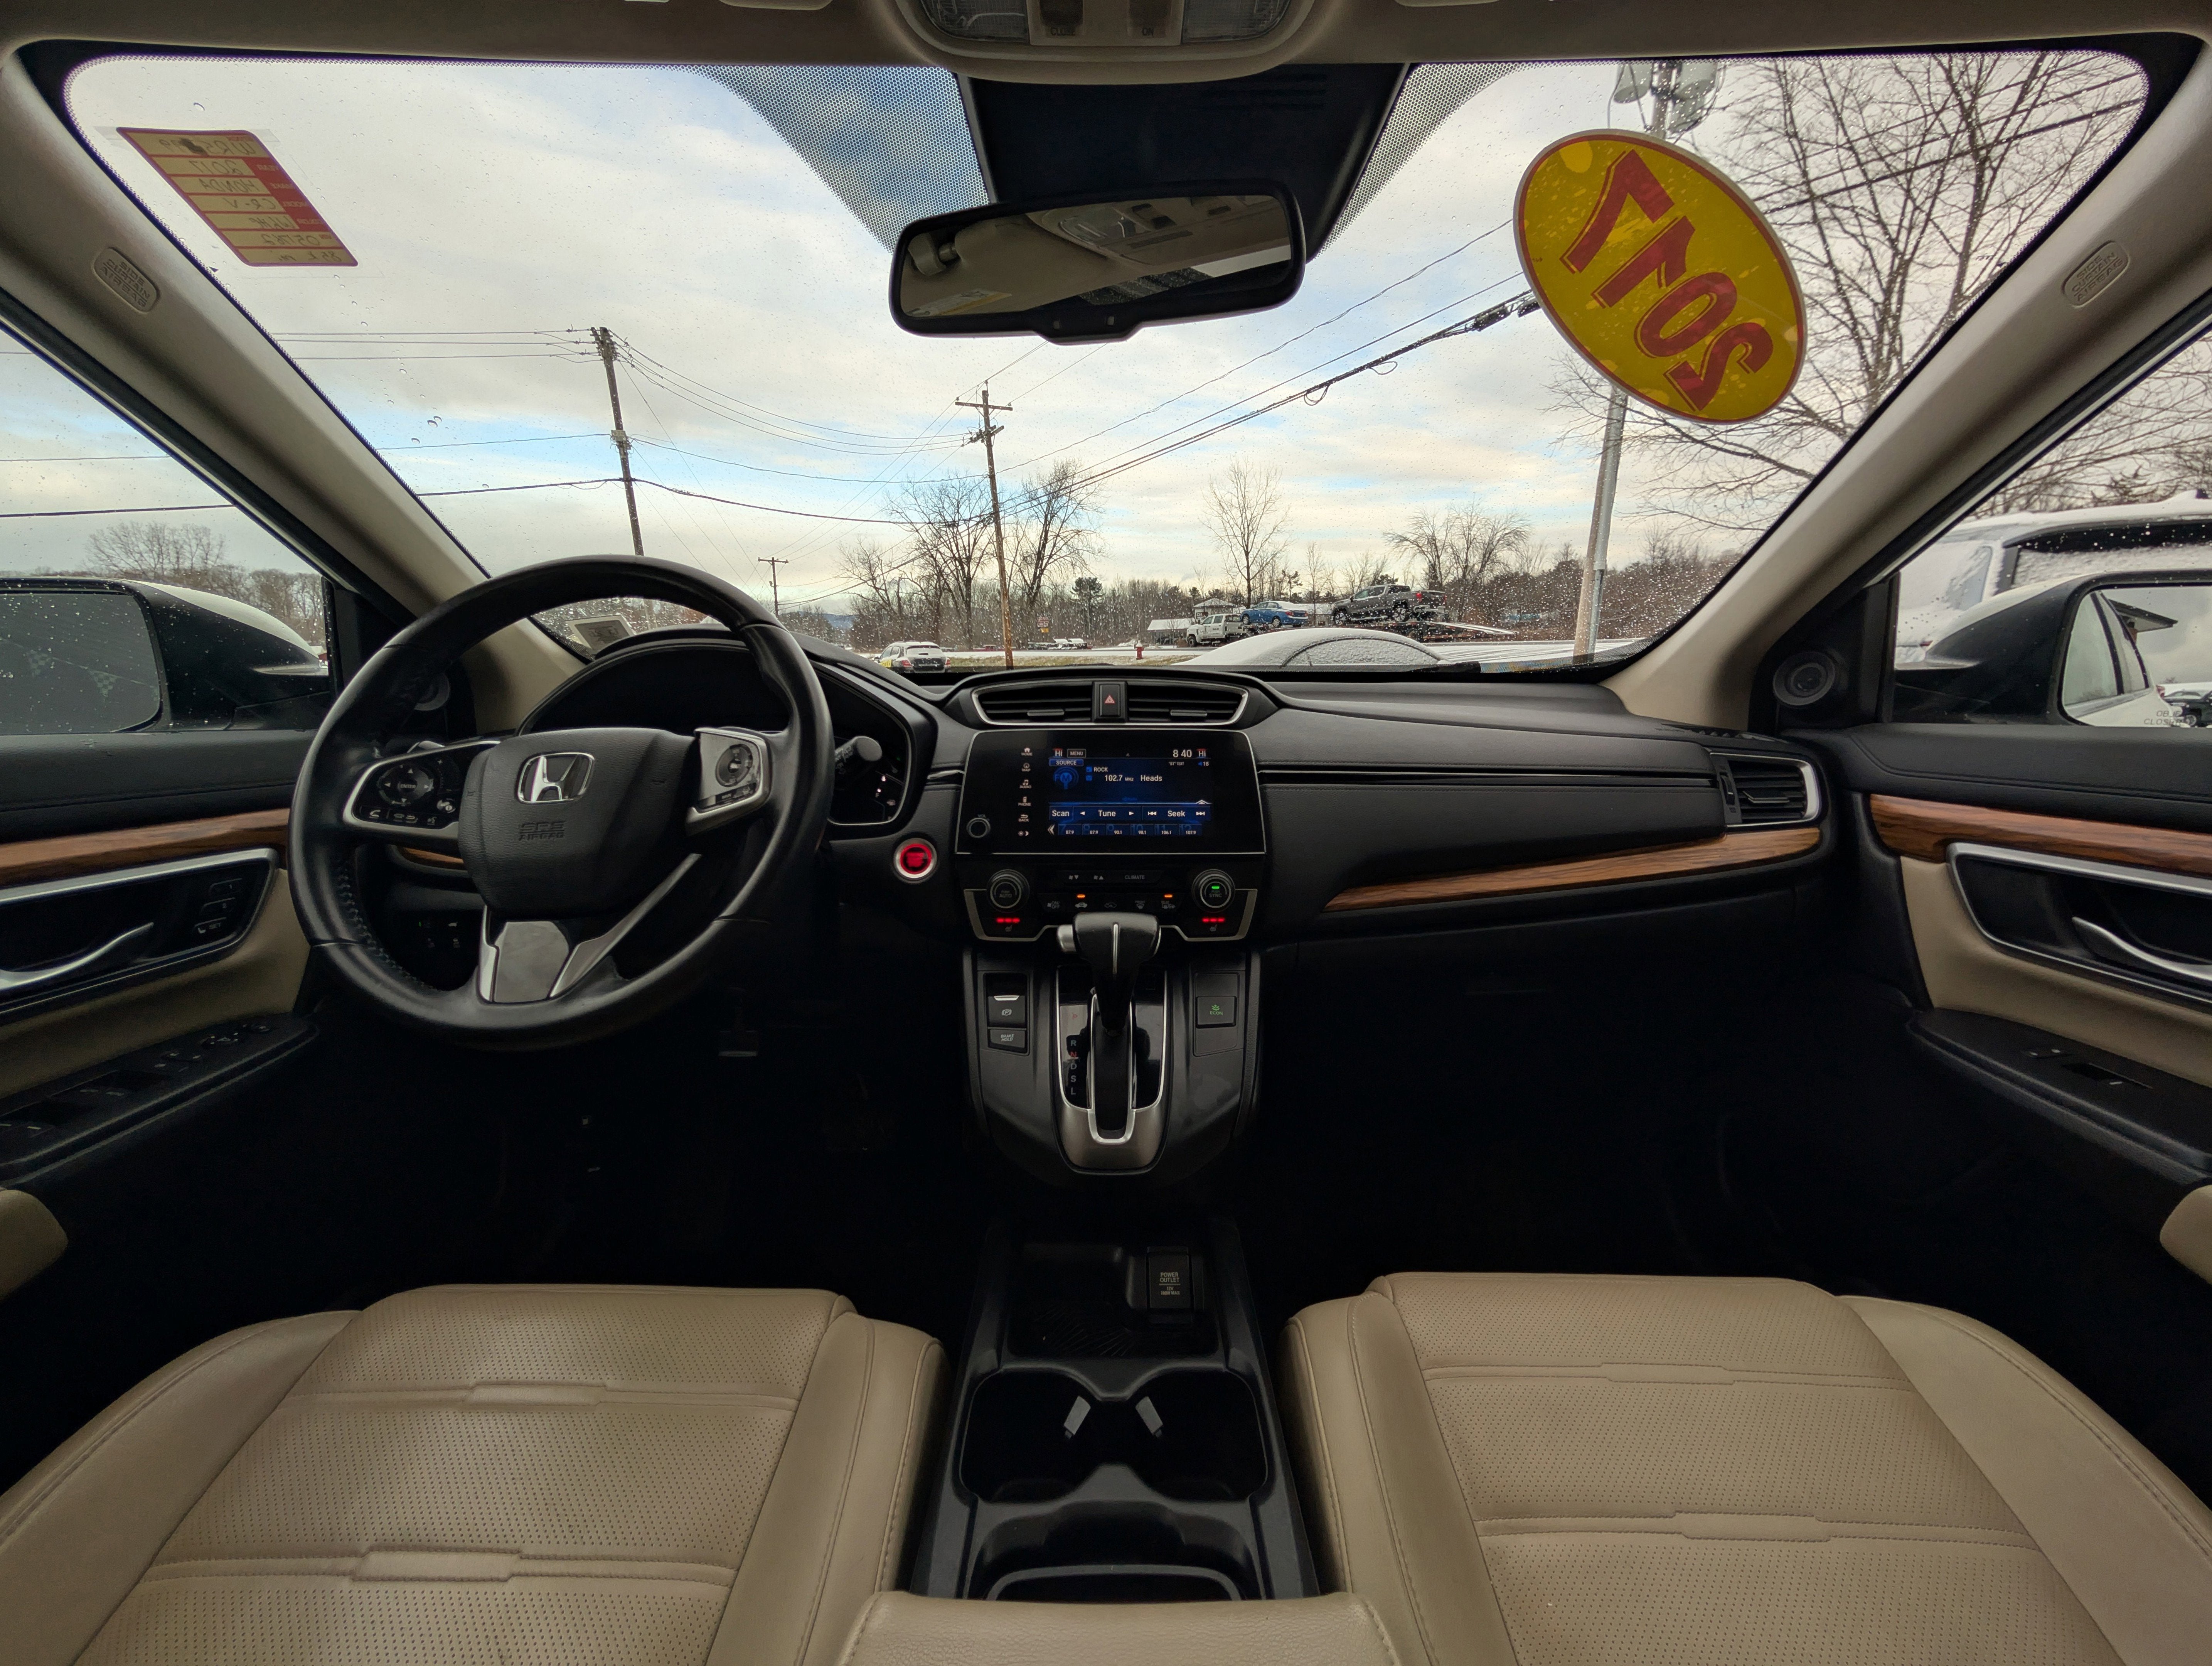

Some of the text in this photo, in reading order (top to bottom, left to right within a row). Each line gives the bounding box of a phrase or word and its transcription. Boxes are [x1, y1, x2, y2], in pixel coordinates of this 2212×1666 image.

[1142, 27, 1154, 36] ON
[106, 258, 150, 298] CURTAIN
[119, 261, 145, 286] SIDE
[2072, 252, 2116, 293] CURTAIN
[2077, 255, 2103, 280] SIDE
[2077, 258, 2123, 302] AIRBAG
[101, 266, 146, 307] AIRBAG
[1071, 1087, 1076, 1095] L
